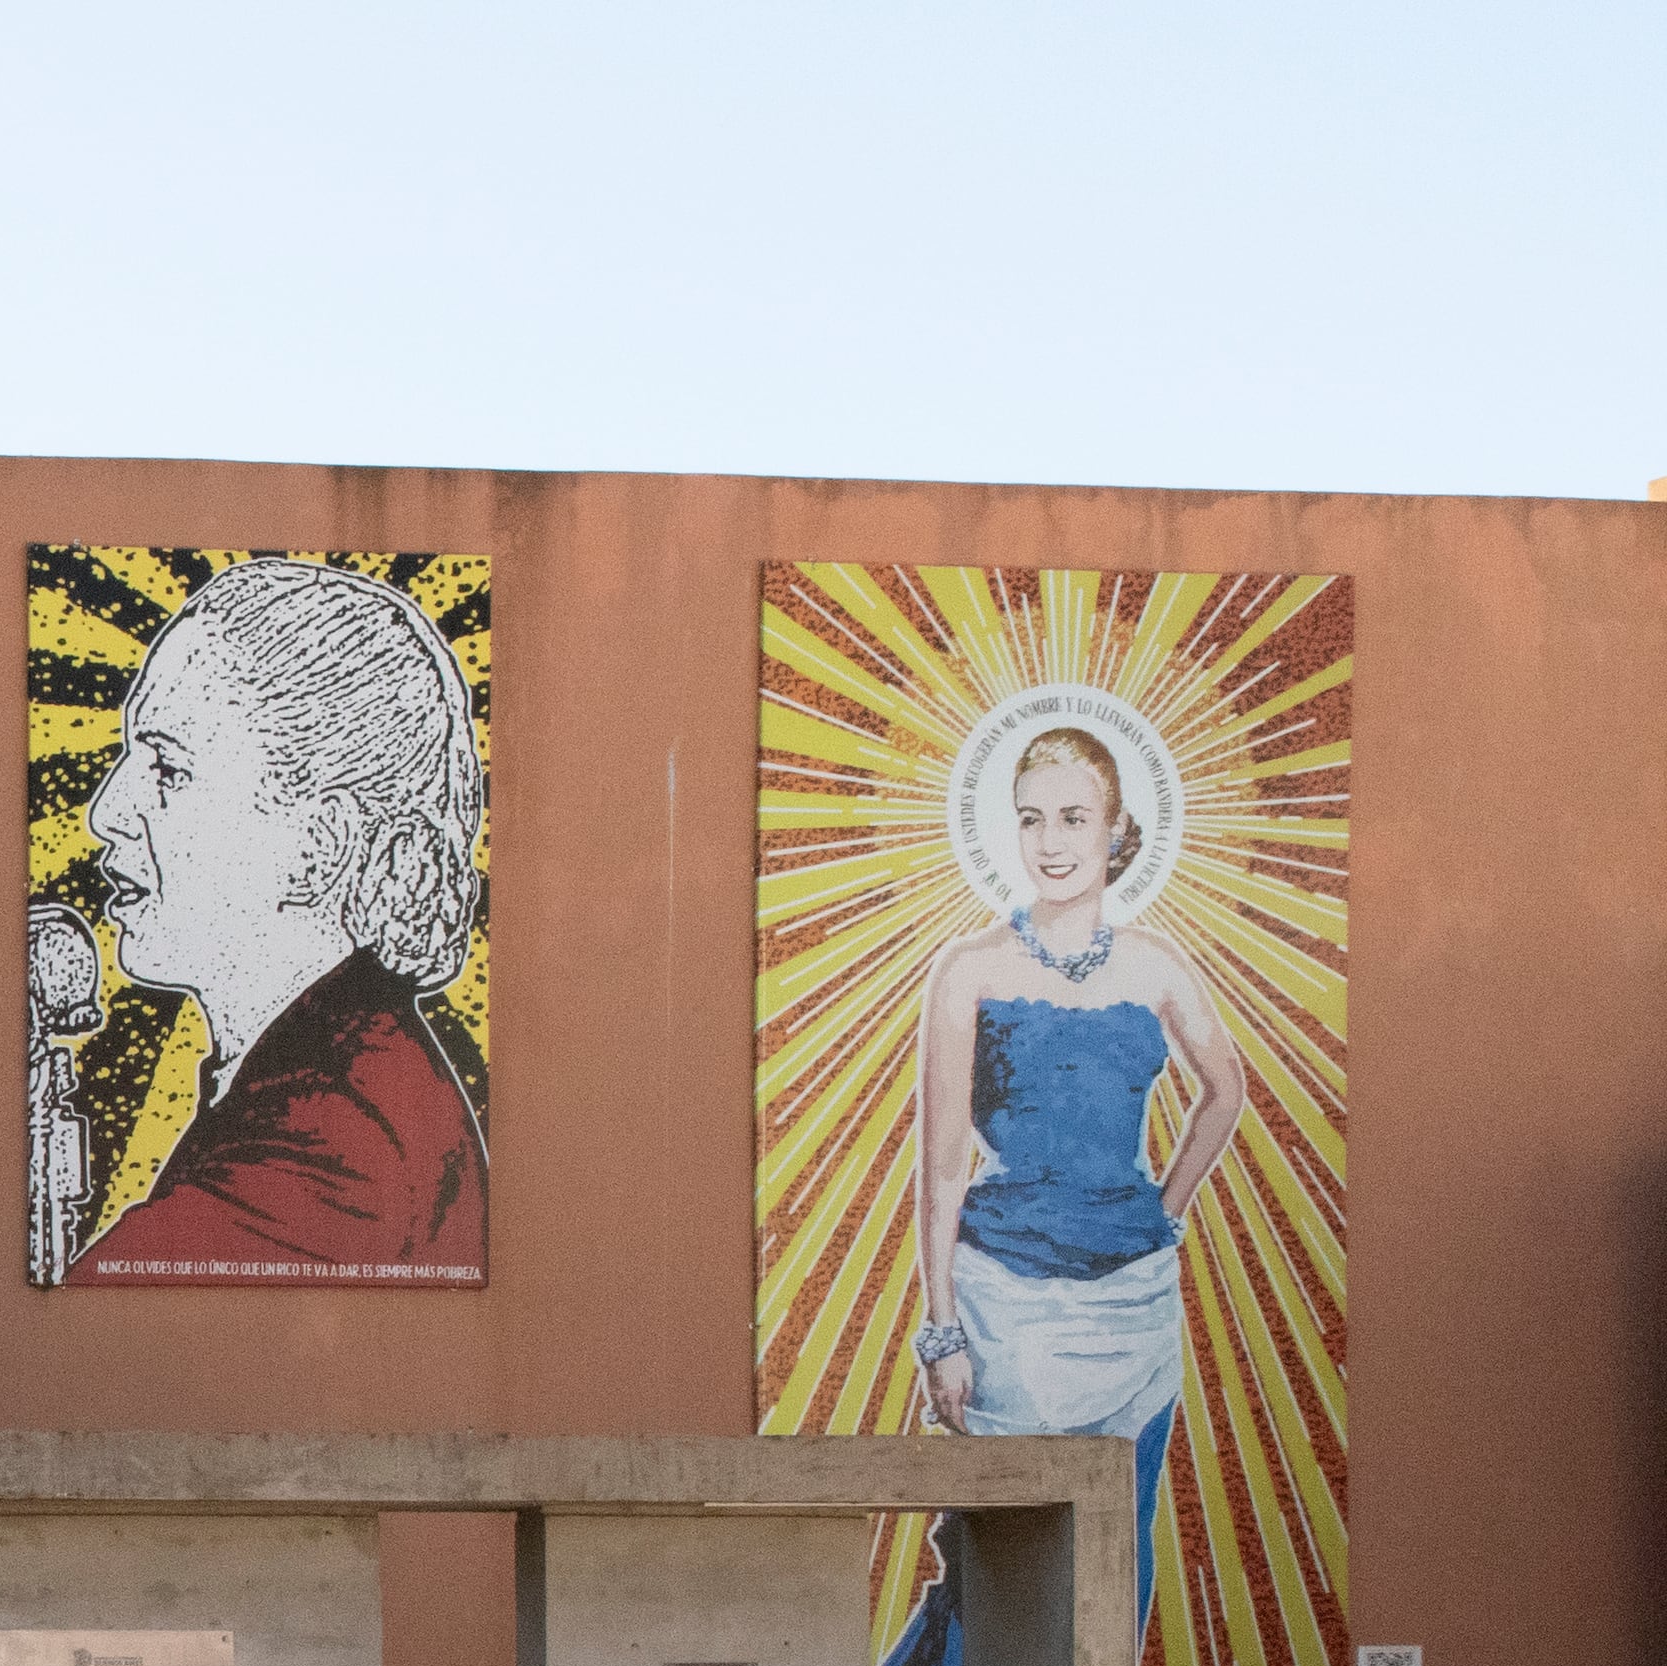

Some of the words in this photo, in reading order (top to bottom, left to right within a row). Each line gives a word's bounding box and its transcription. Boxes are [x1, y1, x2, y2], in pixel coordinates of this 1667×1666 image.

[960, 793, 979, 844] USTEDES
[1001, 713, 1018, 732] MI
[1016, 696, 1062, 721] NOMBRE
[1066, 696, 1074, 713] Y
[1078, 698, 1092, 715] LO
[1140, 744, 1165, 779] COMO
[1155, 778, 1172, 830] BANDERA
[97, 1261, 131, 1274] NUNCA
[133, 1261, 172, 1275] OLVIDES
[173, 1261, 193, 1275] QUE
[194, 1262, 207, 1274] LO
[209, 1259, 238, 1275] ÚNICO
[241, 1262, 260, 1276] QUE
[261, 1262, 275, 1275] UN
[276, 1262, 301, 1276] RICO
[302, 1263, 312, 1276] TE
[314, 1264, 328, 1276] VA
[329, 1264, 337, 1277] A
[363, 1264, 373, 1278] ES
[375, 1265, 413, 1278] SIEMPRE
[414, 1263, 436, 1279] MÁS
